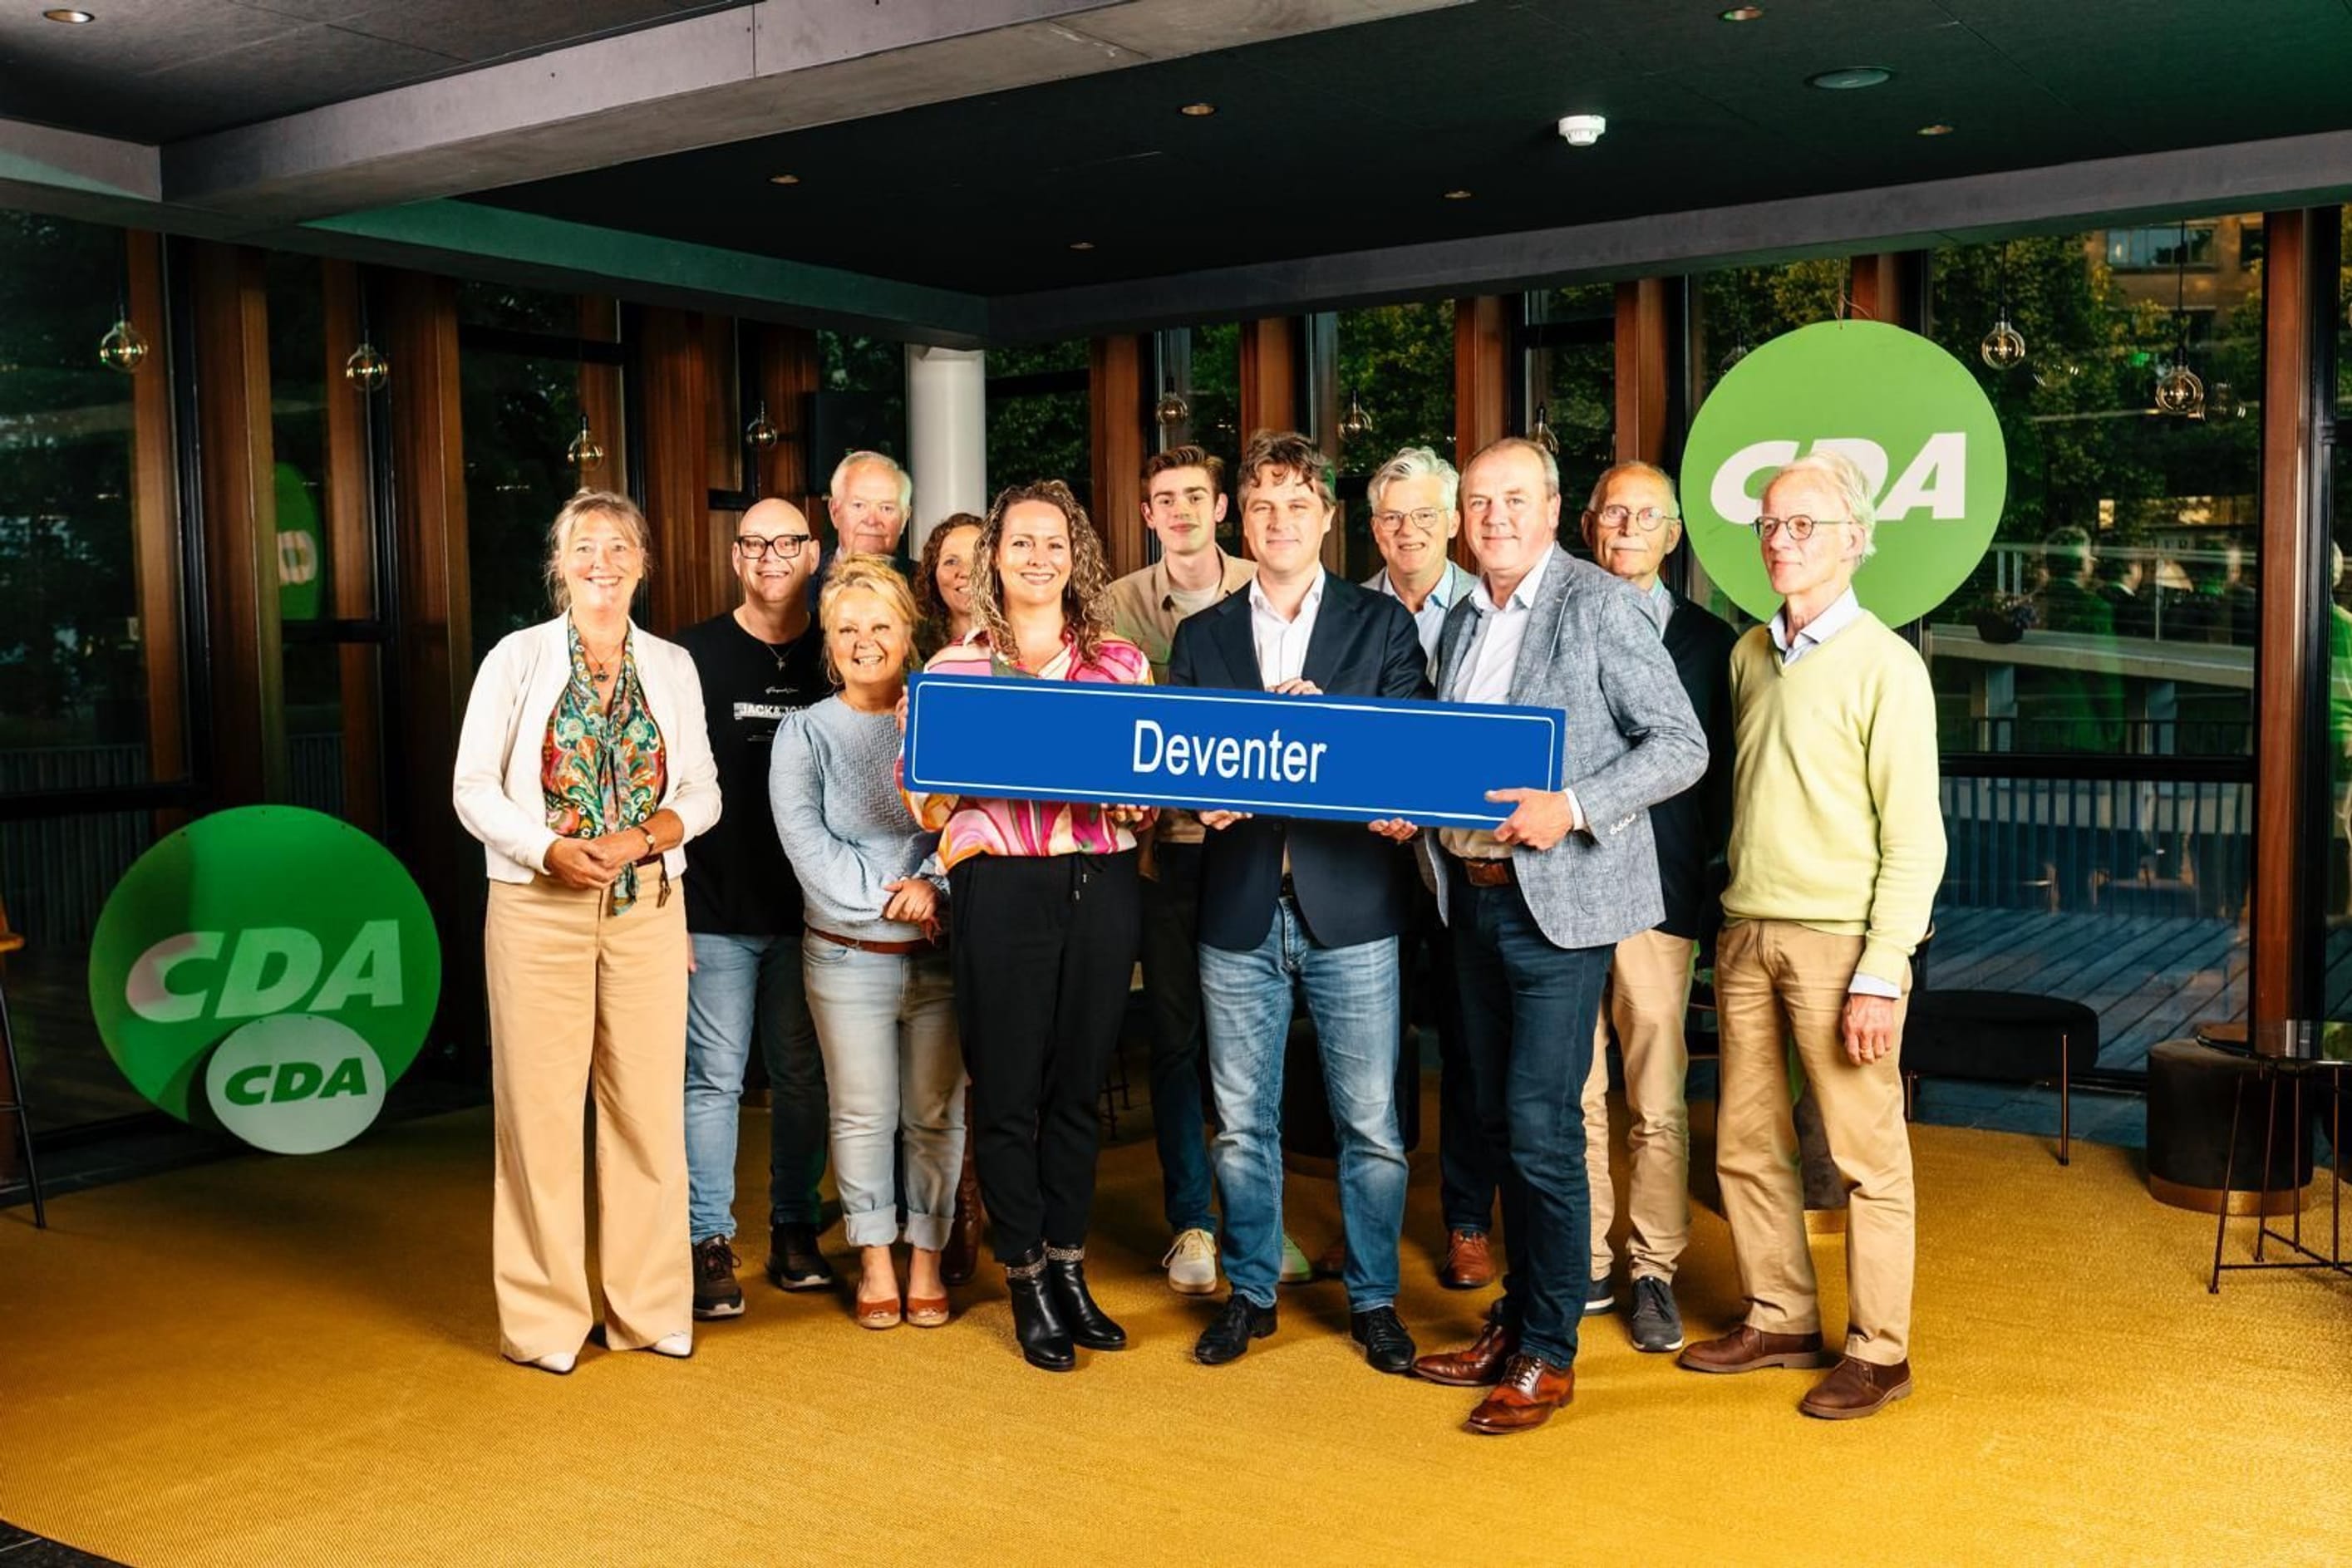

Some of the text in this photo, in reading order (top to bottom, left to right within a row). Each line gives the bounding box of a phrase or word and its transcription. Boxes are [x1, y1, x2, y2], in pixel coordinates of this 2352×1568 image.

[1133, 719, 1327, 783] Deventer
[126, 919, 403, 1022] CDA
[225, 1057, 367, 1106] CDA
